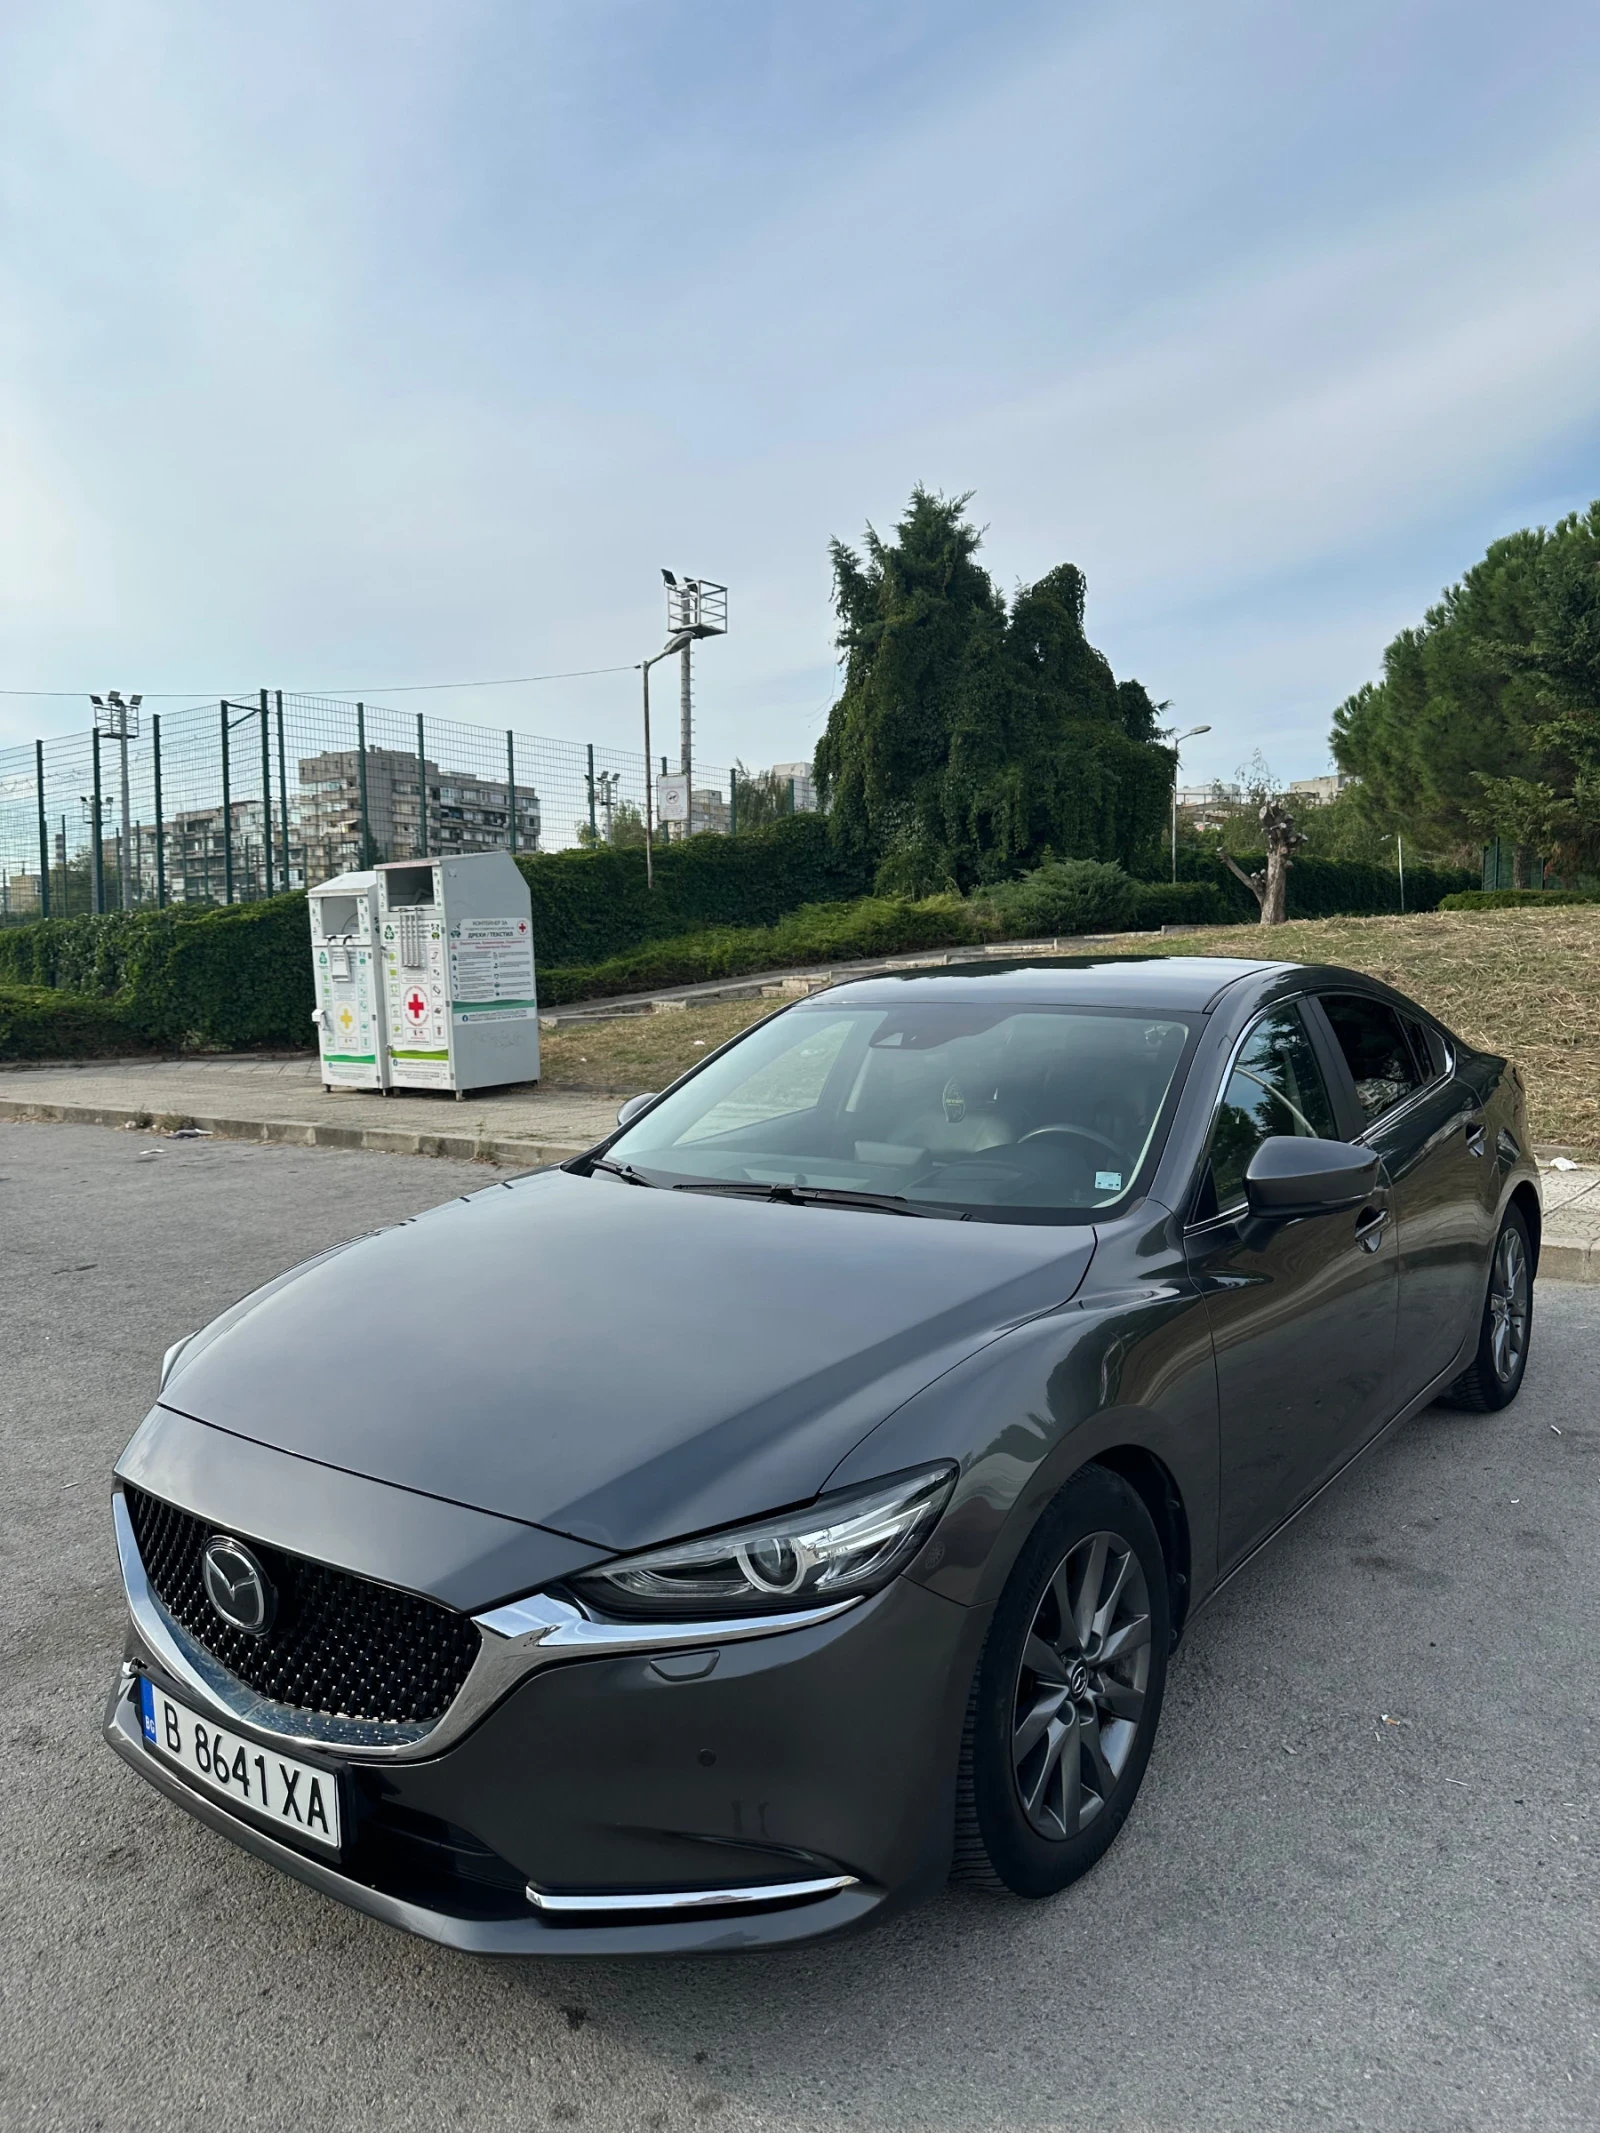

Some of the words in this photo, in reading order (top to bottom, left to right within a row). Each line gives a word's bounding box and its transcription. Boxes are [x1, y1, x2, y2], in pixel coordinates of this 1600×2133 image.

[145, 1715, 155, 1734] BG
[163, 1700, 181, 1753] B
[195, 1723, 268, 1807] 8641
[279, 1762, 329, 1834] XA
